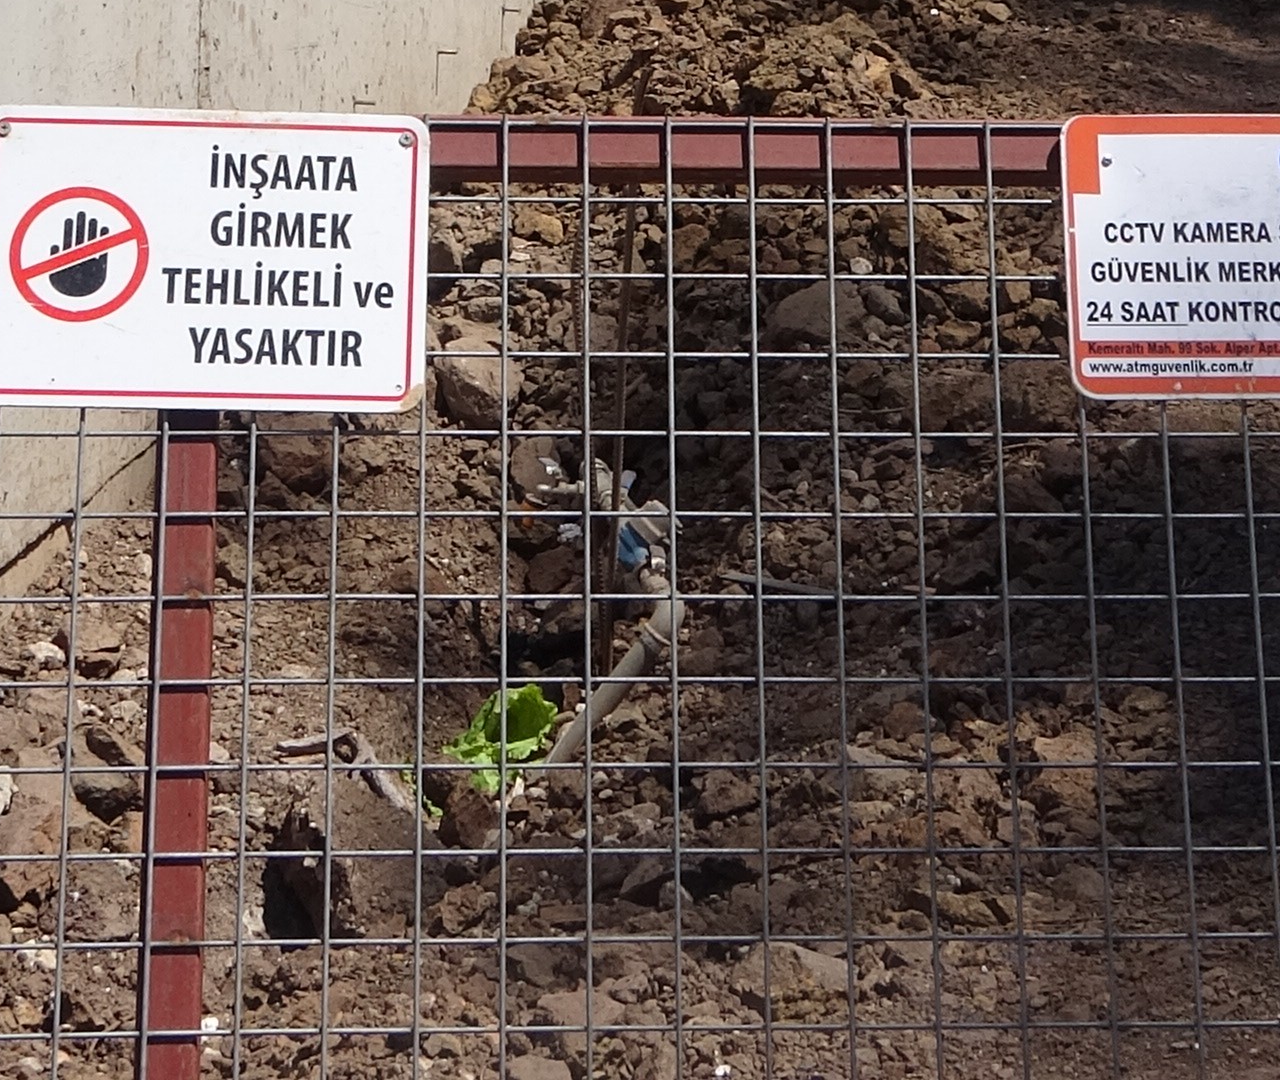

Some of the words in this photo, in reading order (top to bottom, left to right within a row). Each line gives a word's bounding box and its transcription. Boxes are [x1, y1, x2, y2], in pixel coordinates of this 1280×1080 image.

[210, 145, 357, 199] İNŞAATA
[210, 203, 352, 249] GİRMEK
[1104, 223, 1165, 242] CCTV
[1174, 223, 1271, 242] KAMERA
[1091, 257, 1211, 283] GÜVENLİK
[162, 261, 342, 308] TEHLİKELİ
[354, 281, 394, 308] ve
[1086, 302, 1113, 322] 24
[1121, 301, 1180, 322] SAAT
[189, 327, 362, 367] YASAKTIR
[1148, 344, 1175, 354] Mah.
[1089, 360, 1253, 375] www.atmguvenlik.com.tr
